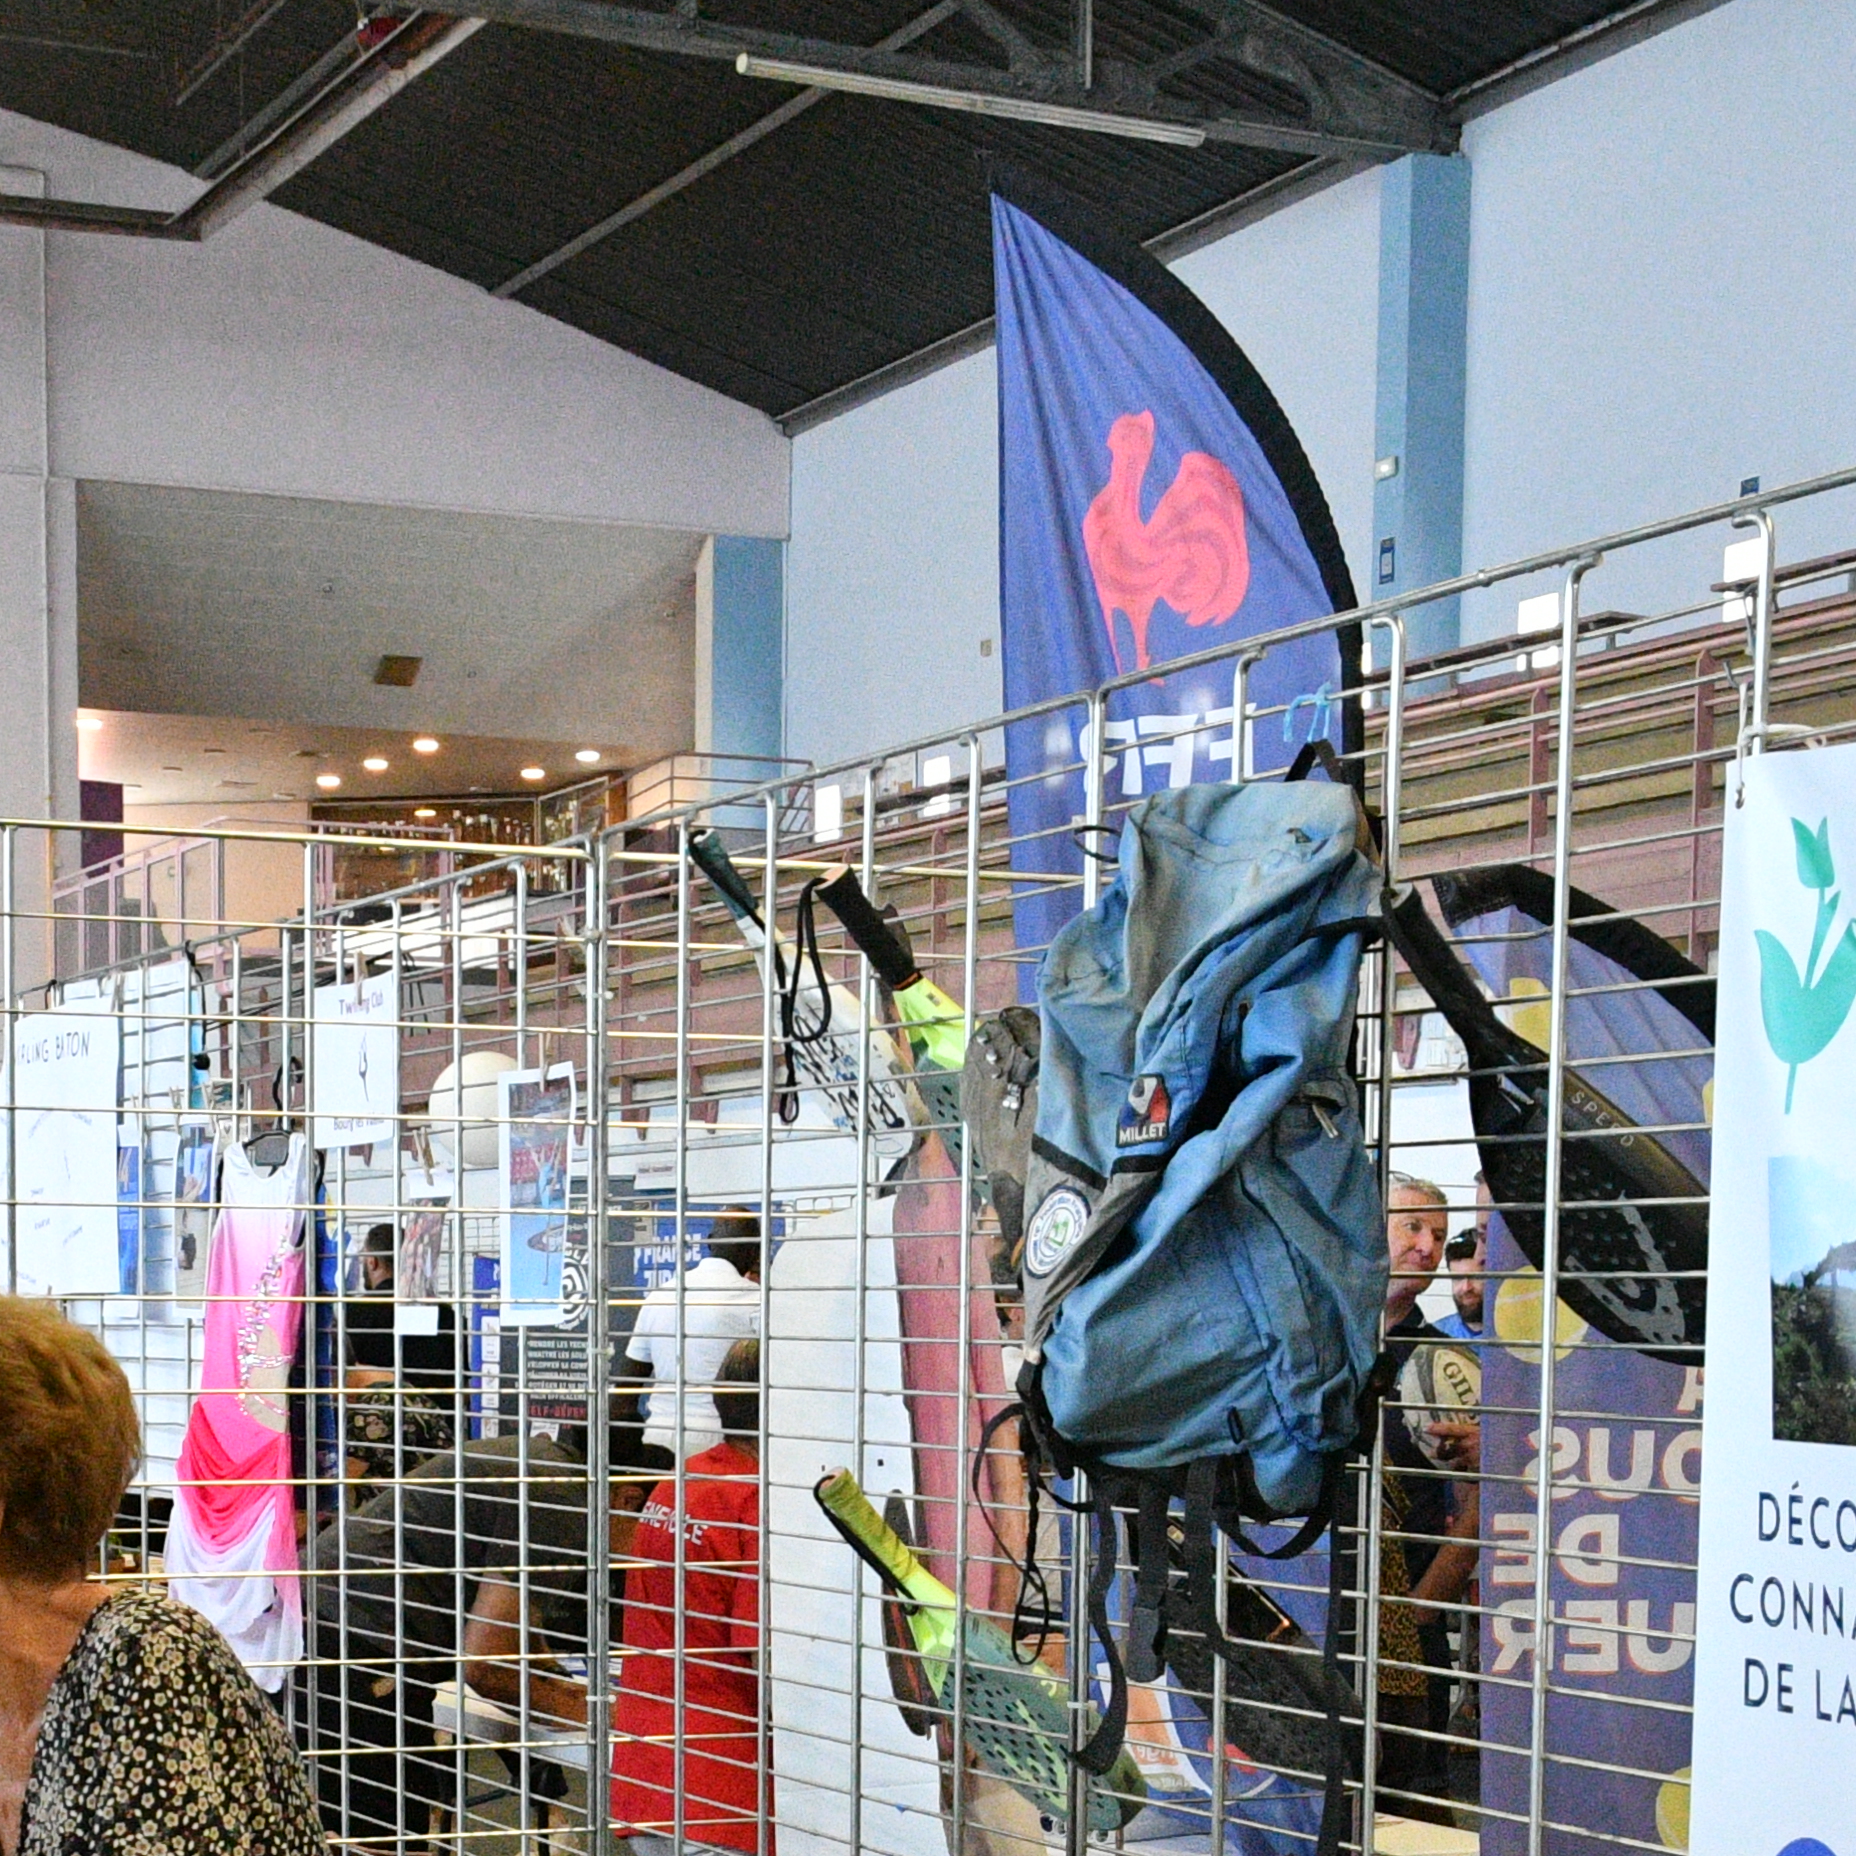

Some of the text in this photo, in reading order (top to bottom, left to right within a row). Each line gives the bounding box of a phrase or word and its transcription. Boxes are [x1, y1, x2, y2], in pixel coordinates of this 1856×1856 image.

[1119, 1122, 1166, 1144] MILLET
[1743, 1657, 1795, 1716] DE
[1814, 1670, 1856, 1728] LA
